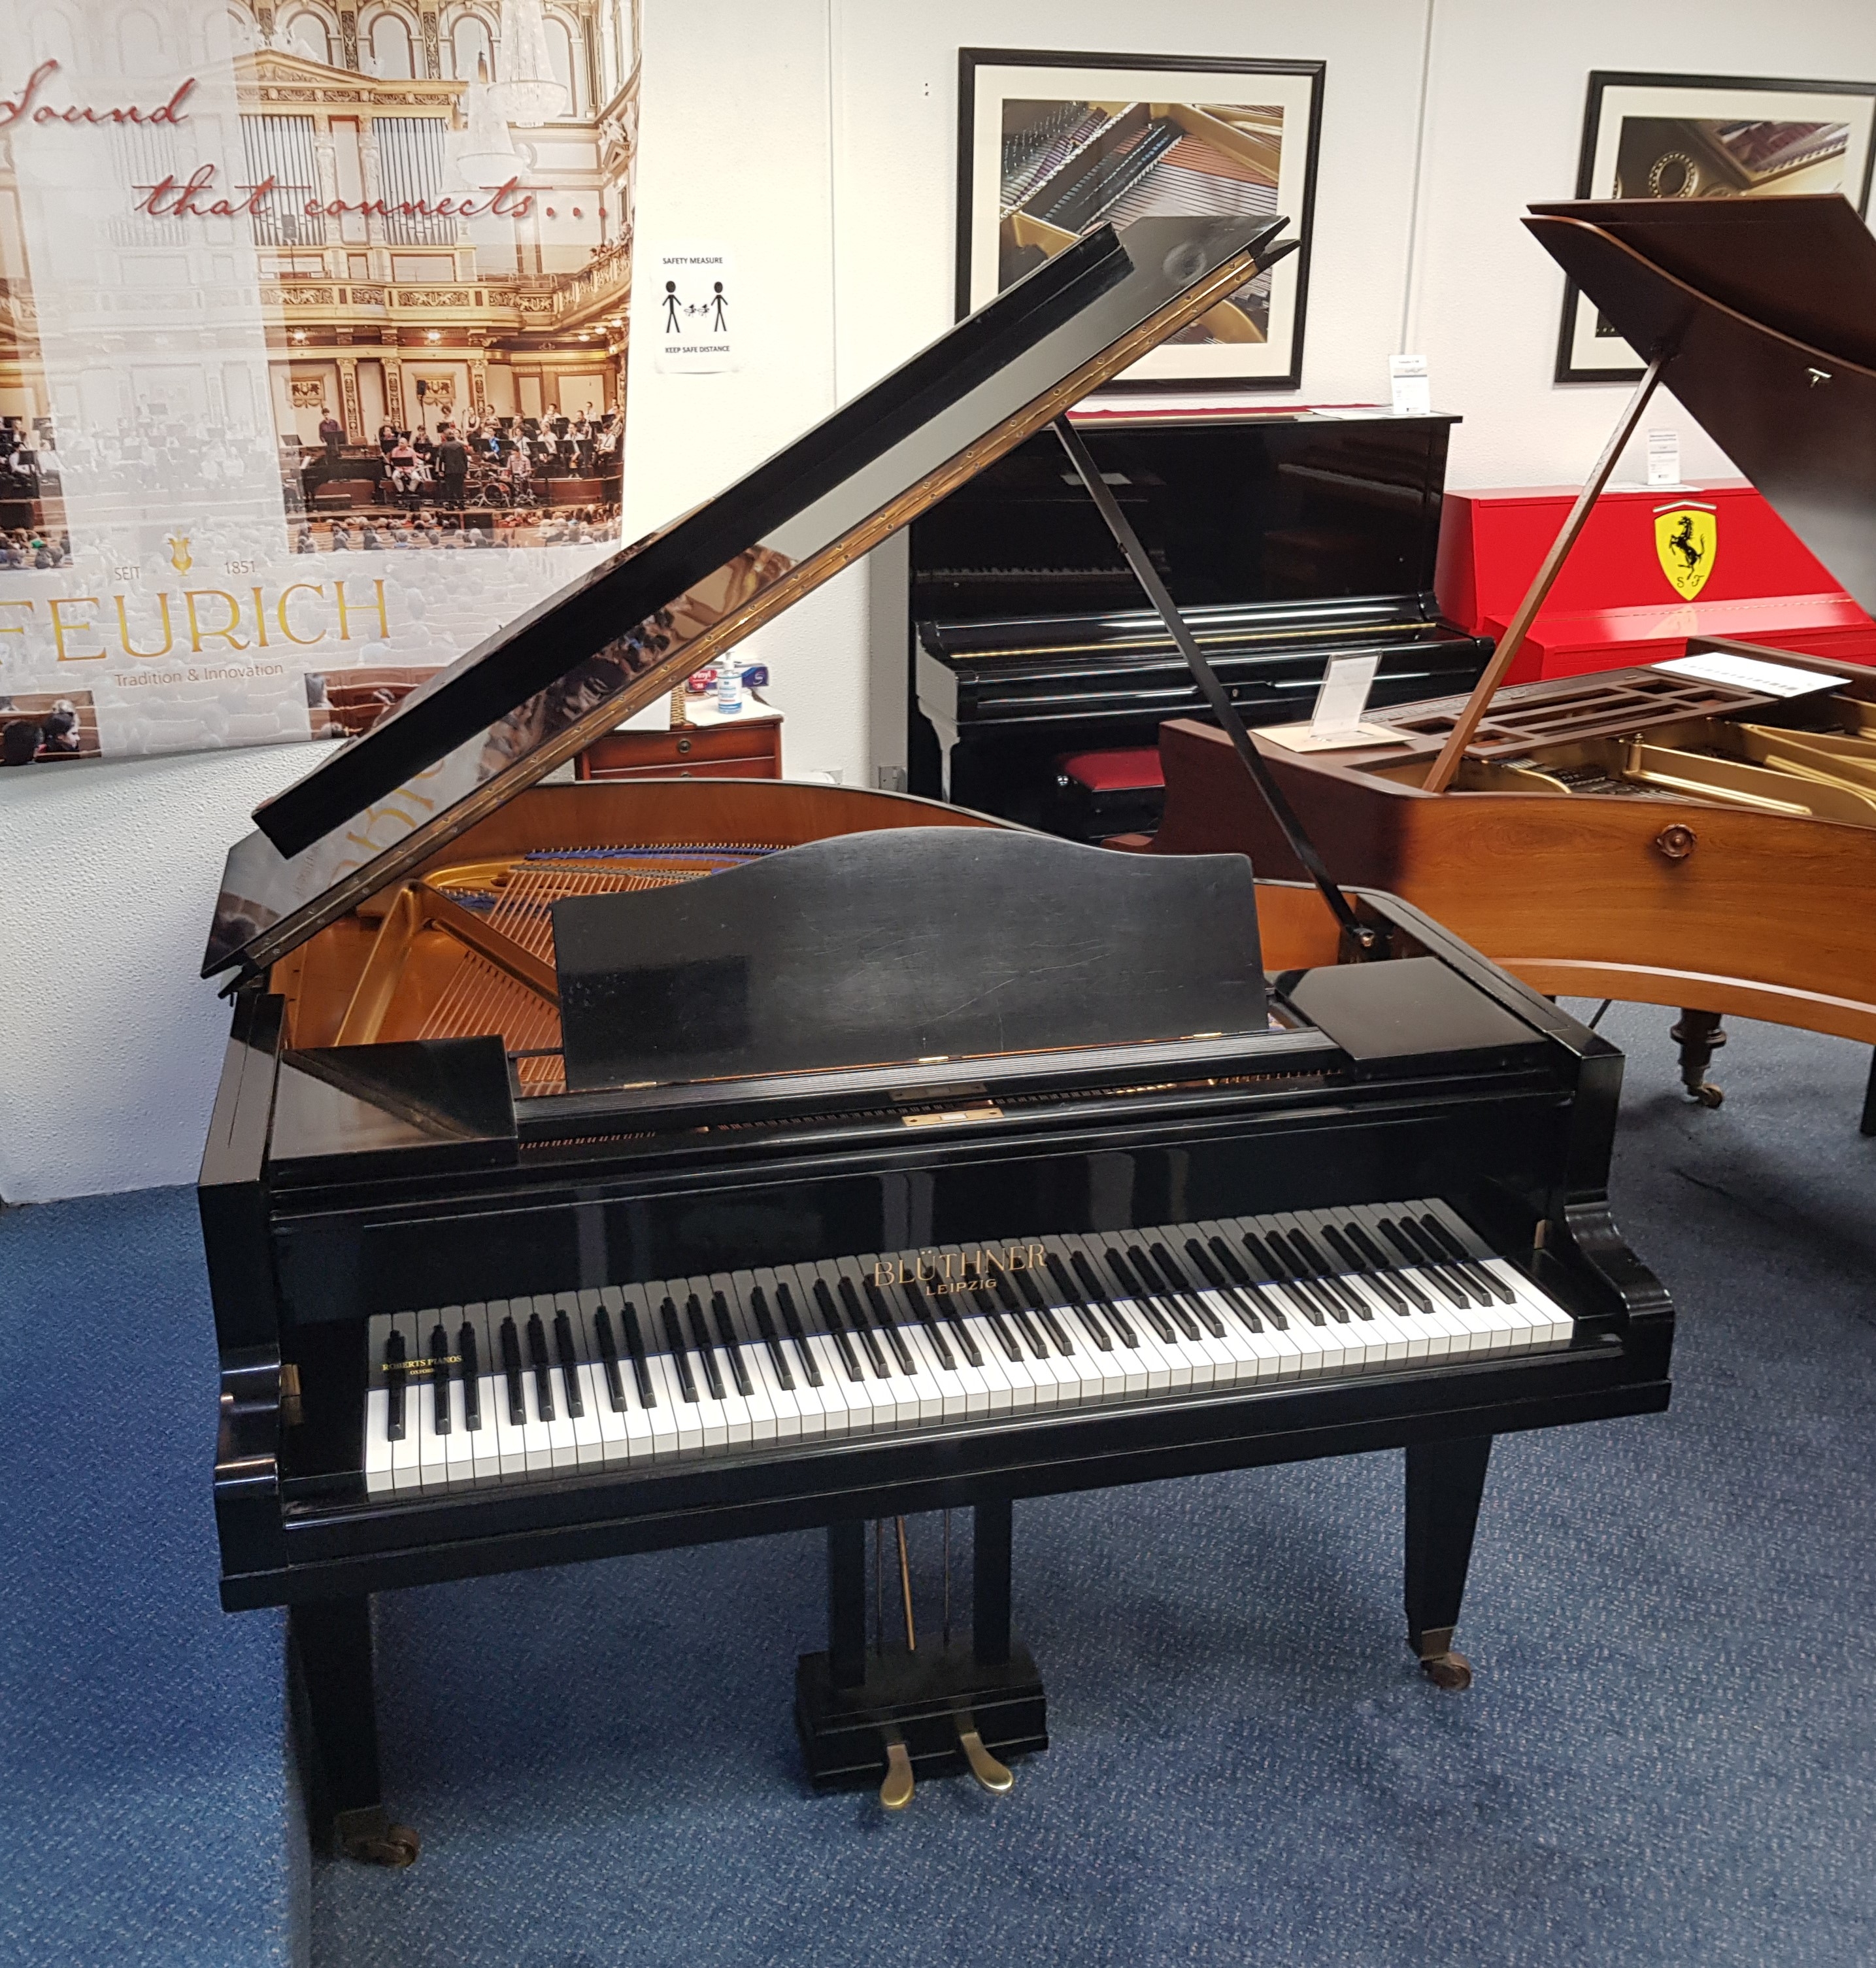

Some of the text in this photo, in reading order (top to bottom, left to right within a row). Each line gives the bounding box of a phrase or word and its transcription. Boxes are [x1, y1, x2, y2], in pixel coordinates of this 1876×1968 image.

[0, 58, 195, 126] Sound
[132, 164, 311, 216] that
[114, 560, 256, 581] SEIT 1851
[114, 664, 284, 687] Tradition & Innovation
[874, 1243, 1048, 1287] BLÜTHNER
[926, 1278, 997, 1296] LEIPZIG
[381, 1355, 463, 1371] ROBERTS PIANOS
